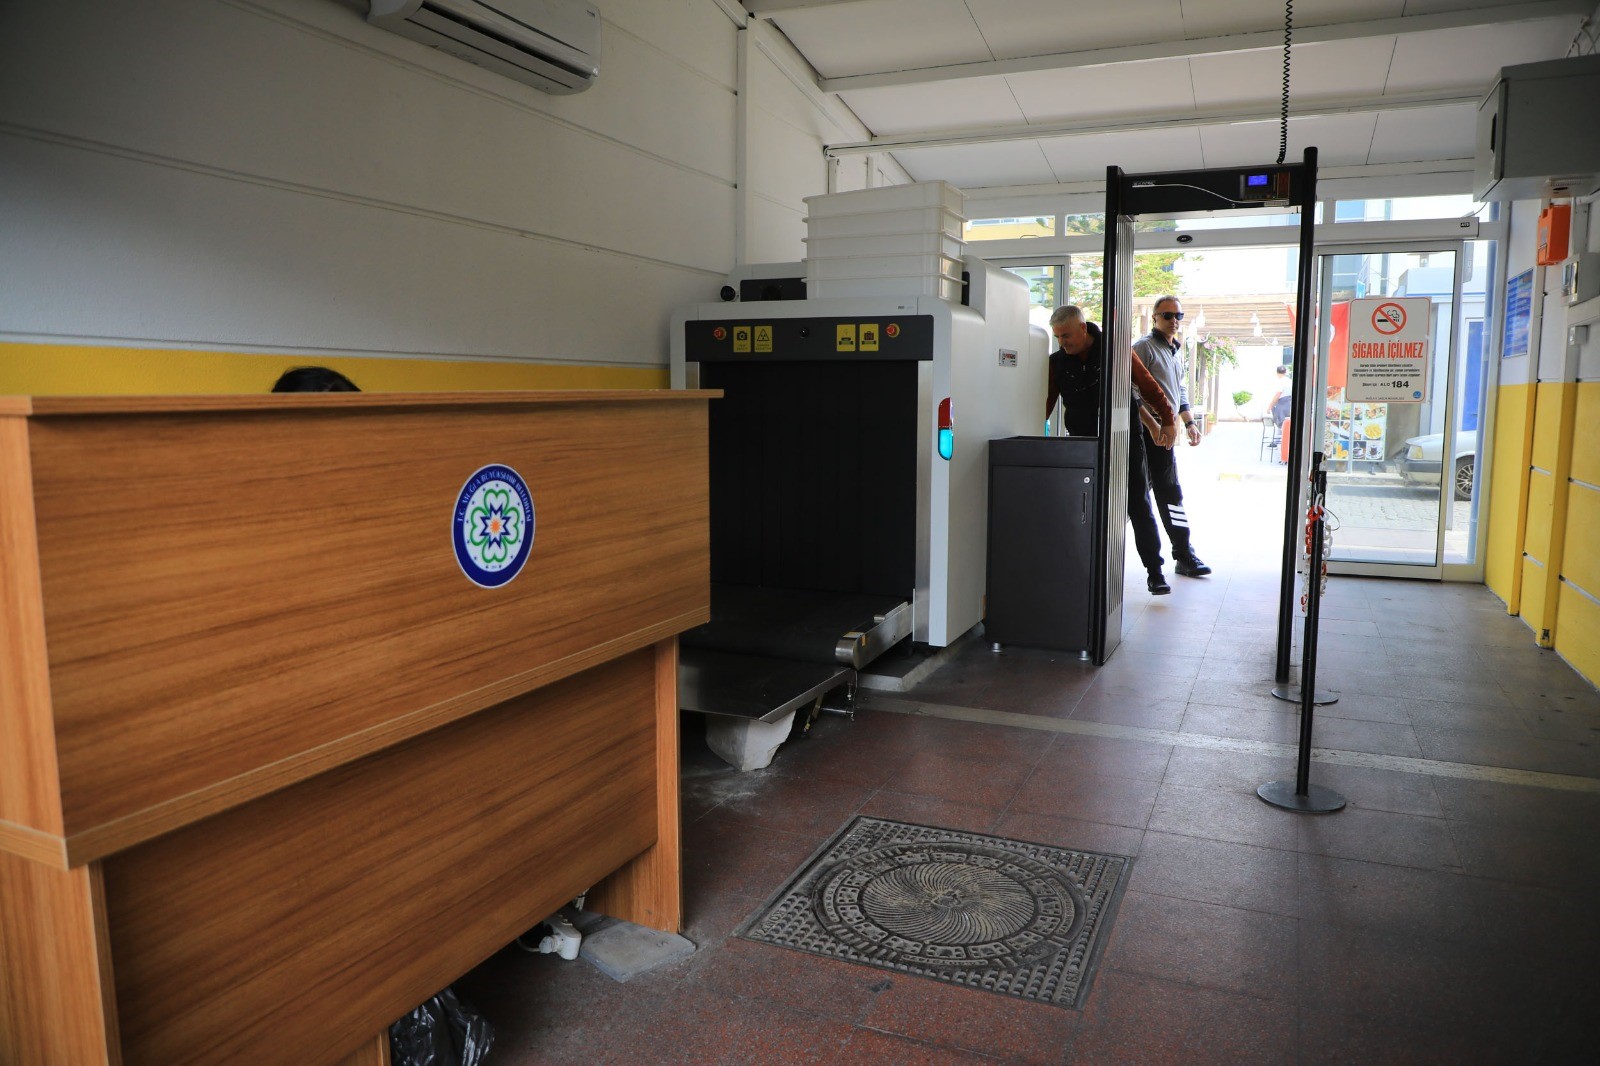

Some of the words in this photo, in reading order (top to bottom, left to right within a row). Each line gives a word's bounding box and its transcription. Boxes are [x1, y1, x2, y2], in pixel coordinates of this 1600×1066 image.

[1352, 340, 1385, 359] SİGARA
[1387, 339, 1424, 361] İÇİLMEZ
[1391, 380, 1409, 388] 184
